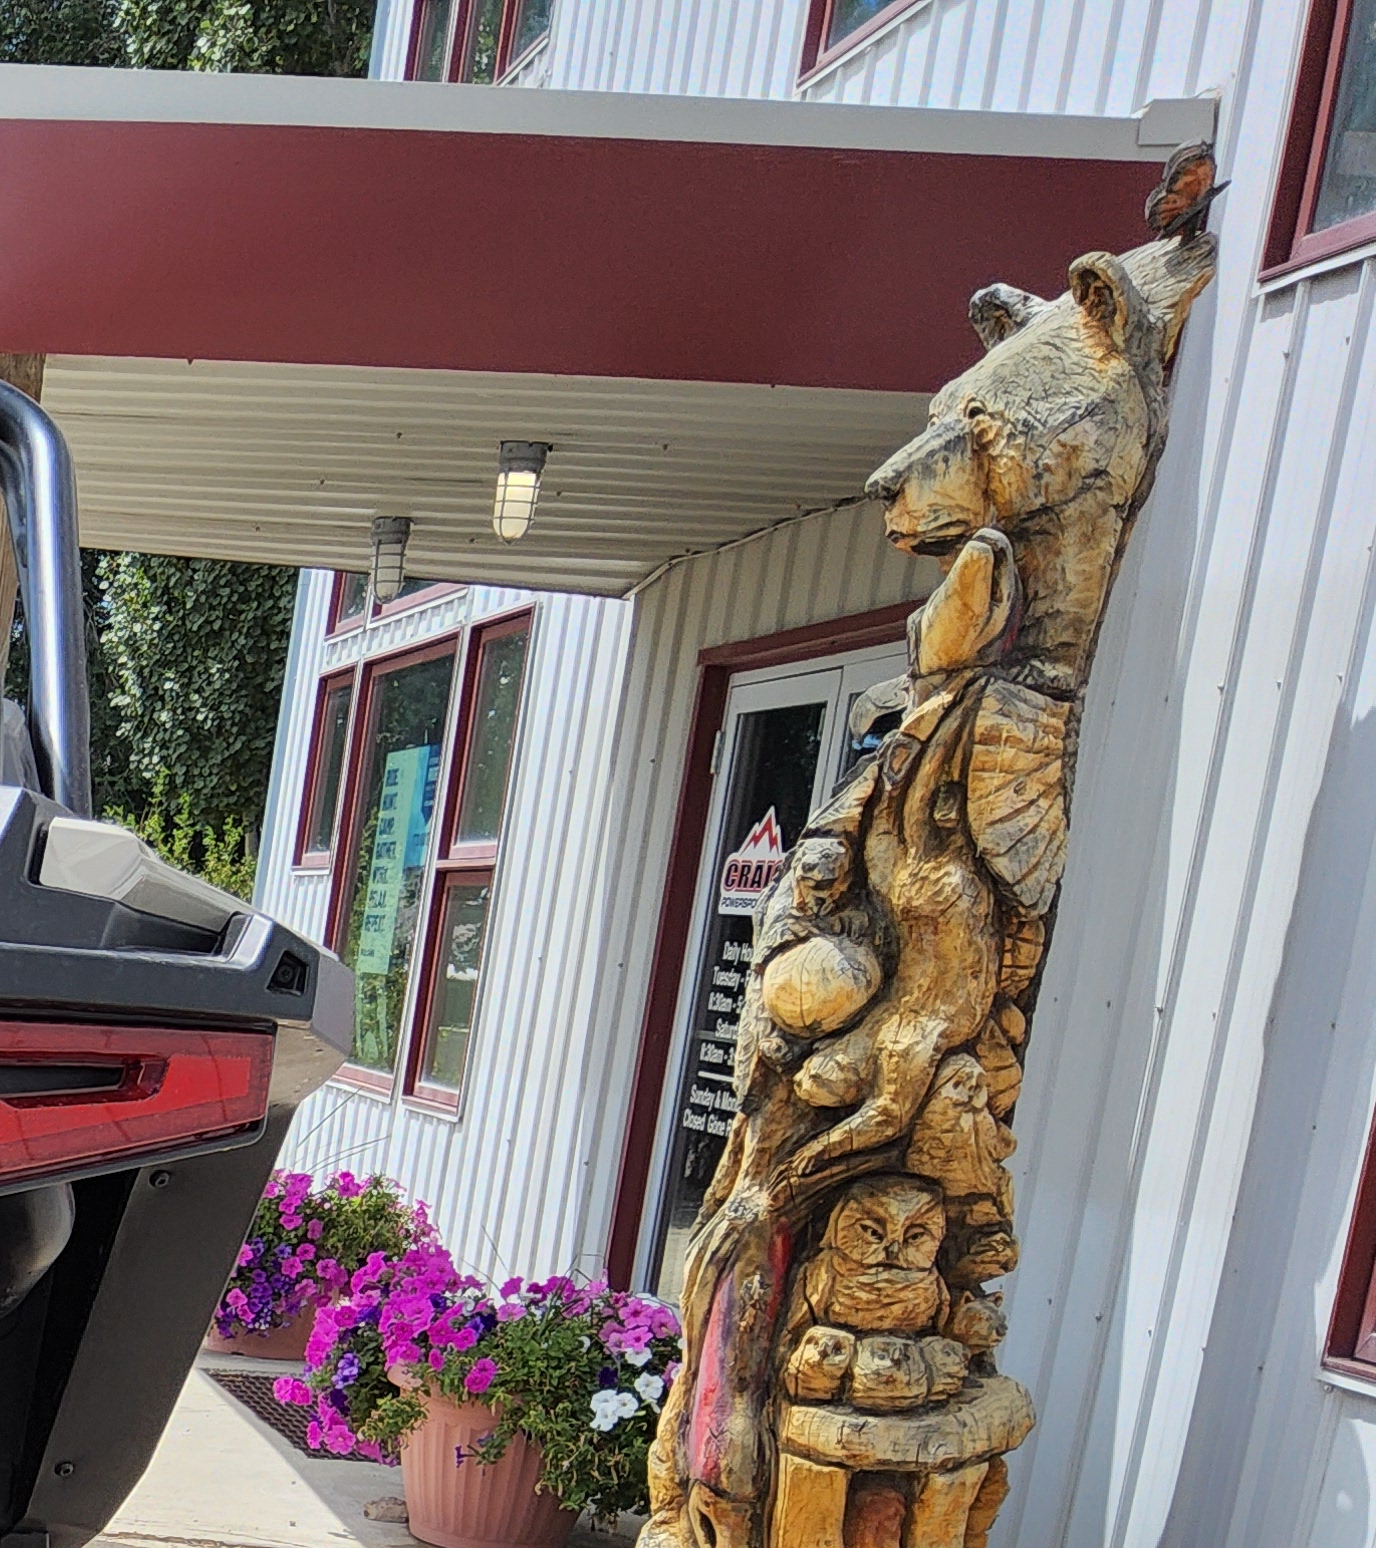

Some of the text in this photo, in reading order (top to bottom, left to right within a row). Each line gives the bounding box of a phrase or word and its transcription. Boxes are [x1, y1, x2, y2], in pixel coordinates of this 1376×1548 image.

[721, 897, 758, 909] POWERSPO
[722, 941, 741, 965] Daily
[712, 966, 741, 991] Tuesday
[715, 1018, 739, 1039] Saturd
[690, 1084, 715, 1111] Sunday
[683, 1108, 707, 1131] Closed
